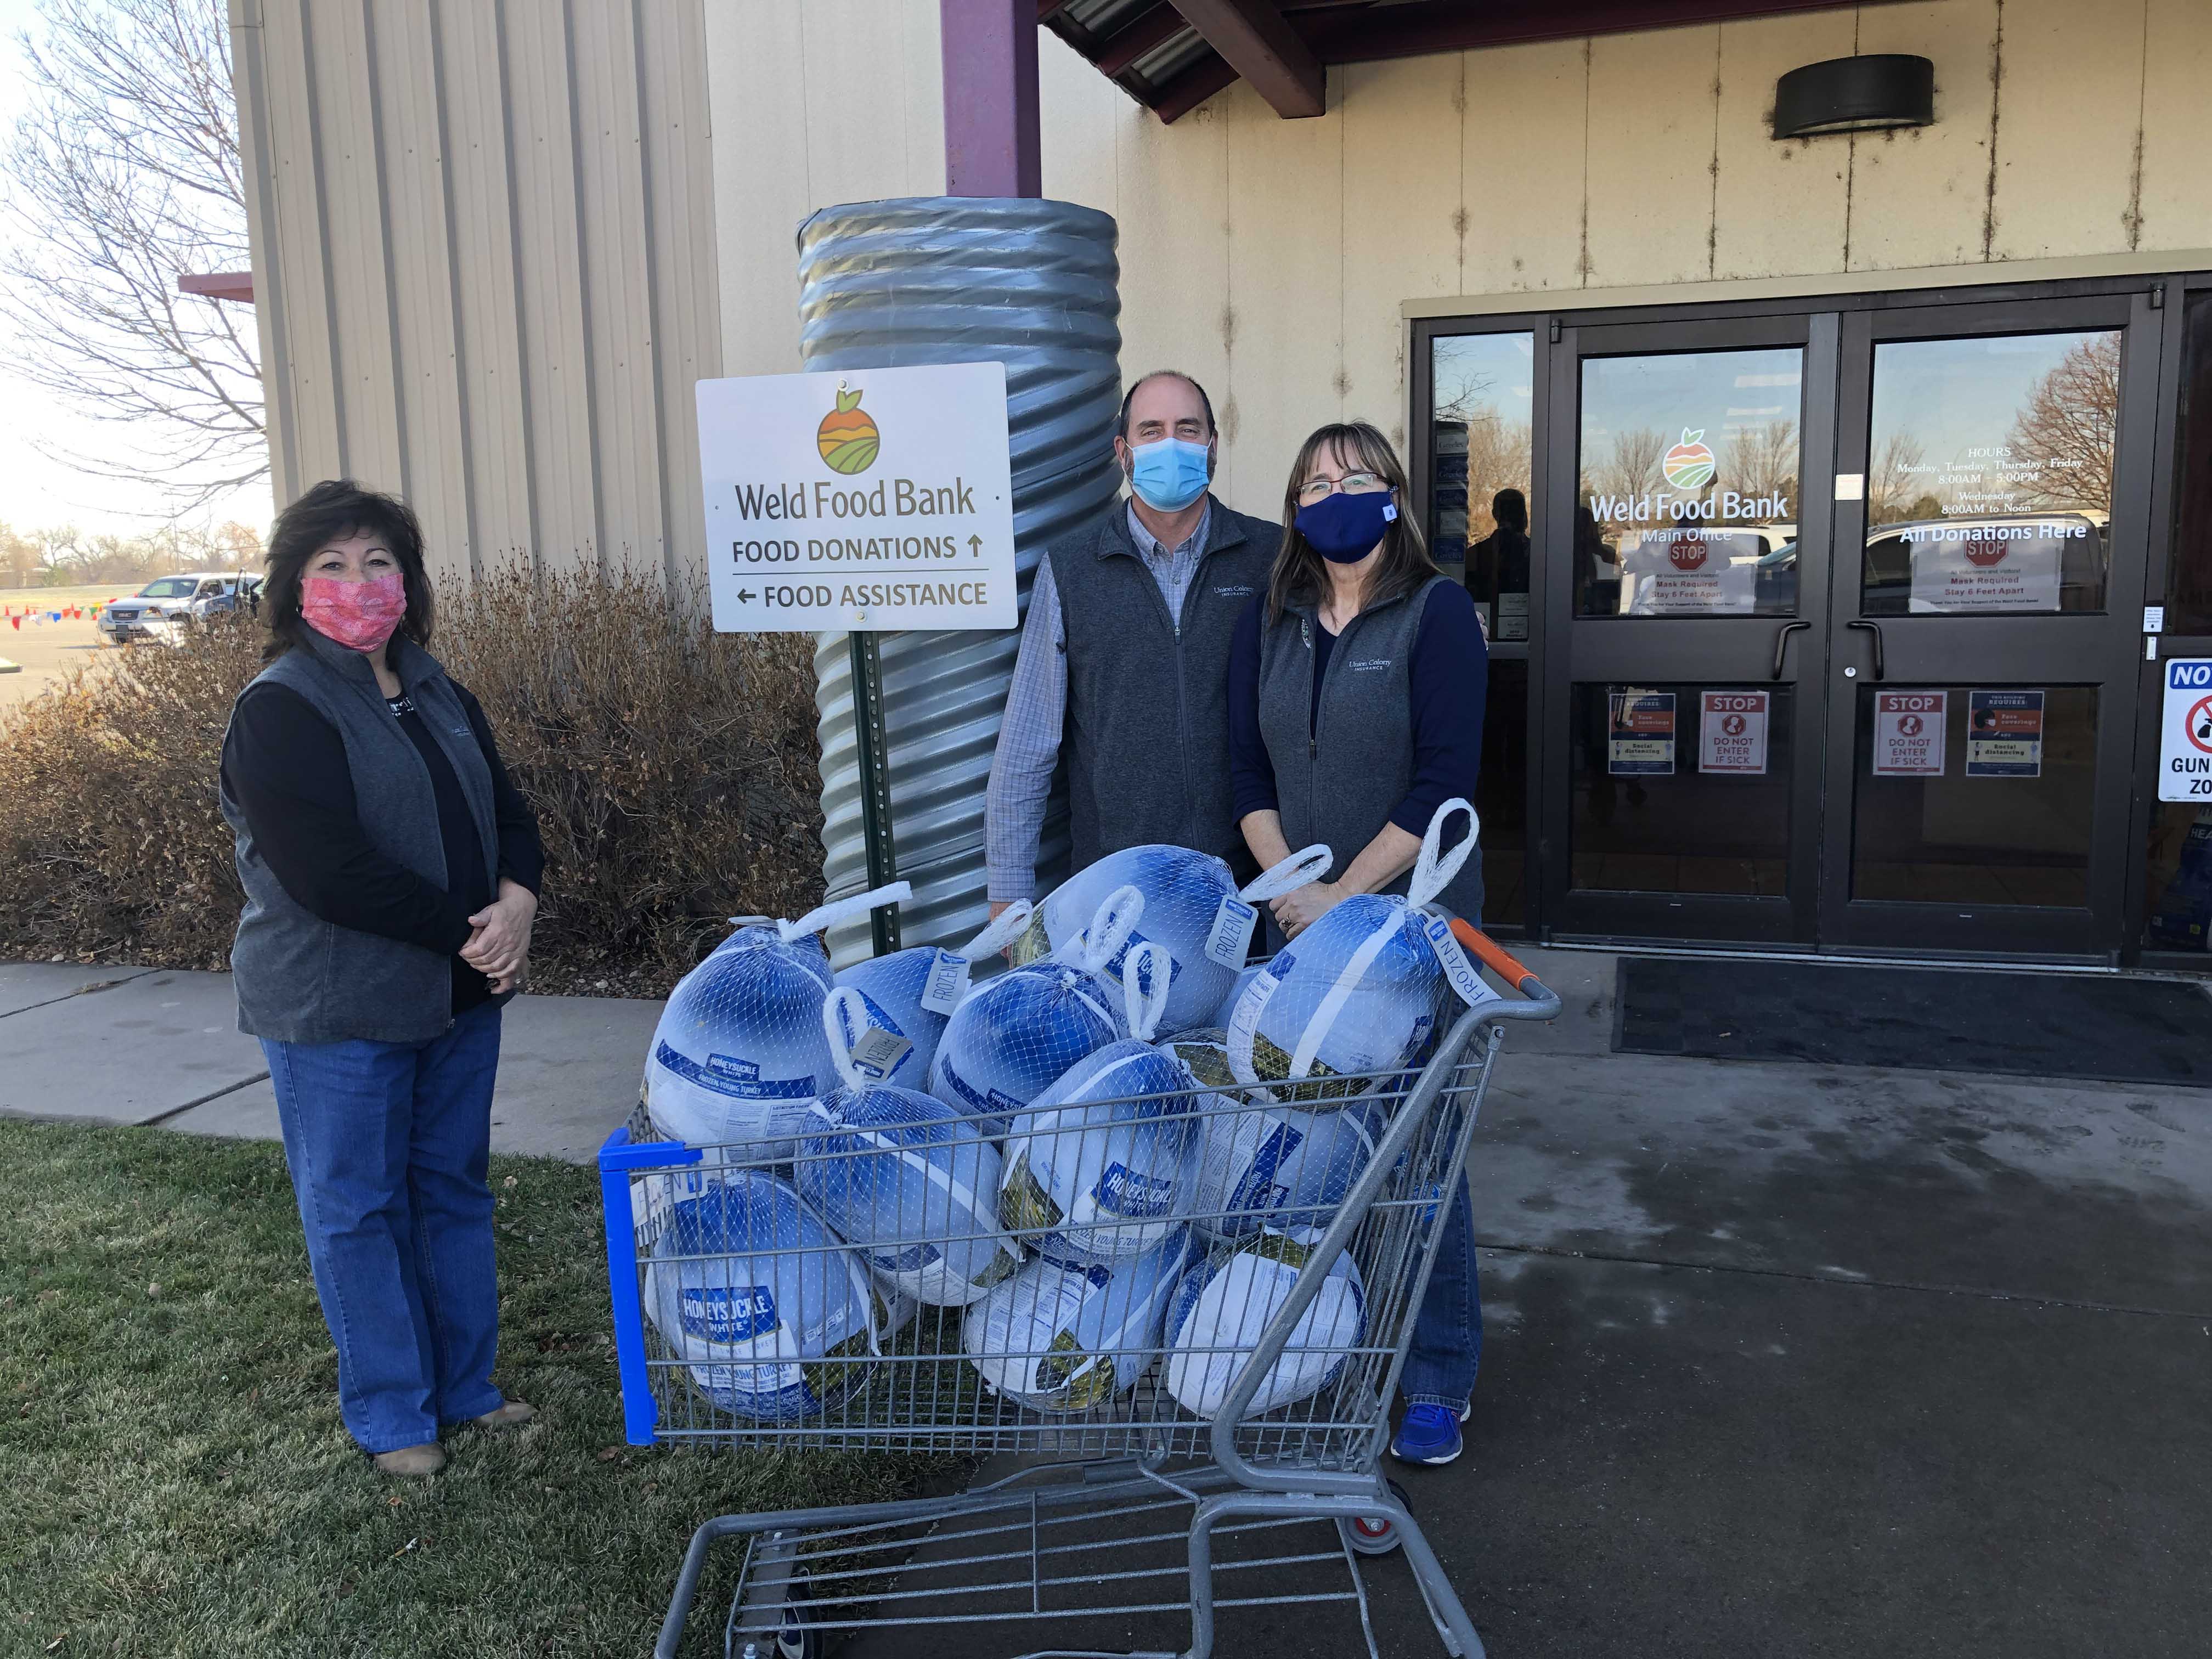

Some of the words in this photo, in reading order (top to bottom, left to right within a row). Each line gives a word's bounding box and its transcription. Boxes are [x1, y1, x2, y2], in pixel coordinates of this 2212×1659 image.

[1967, 447, 2011, 458] HOURS
[1994, 459, 2045, 471] Thursday,
[2050, 458, 2083, 469] Friday
[1938, 474, 1981, 484] 8:00AM
[1996, 472, 2039, 482] 5:00PM
[735, 482, 806, 520] Weld
[815, 480, 886, 518] Food
[894, 477, 975, 517] Bank
[1959, 492, 2015, 501] Wednesday
[1590, 494, 1650, 522] Weld
[1656, 492, 1716, 521] Food
[1723, 490, 1788, 519] Bank
[1941, 504, 1984, 515] 8:00AM
[1989, 505, 1999, 514] to
[2004, 503, 2031, 512] Noon
[1642, 529, 1681, 543] Main
[1686, 527, 1732, 542] Office
[1900, 528, 1925, 543] All
[1931, 525, 2032, 542] Donations
[2039, 524, 2087, 539] Here
[733, 540, 799, 563] FOOD
[808, 536, 957, 561] DONATIONS
[1671, 545, 1707, 561] STOP
[1967, 541, 2006, 555] STOP
[1977, 577, 2019, 585] Required
[765, 585, 832, 607] FOOD
[840, 583, 988, 607] ASSISTANCE
[1945, 588, 1967, 596] Stay
[1369, 658, 1392, 667] Colony
[2174, 665, 2212, 686] NO
[1713, 697, 1757, 711] STOP
[1888, 697, 1934, 710] STOP
[1714, 738, 1730, 746] DO
[1717, 747, 1750, 755] ENTER
[1715, 756, 1725, 764] IF
[1726, 755, 1750, 764] SICK
[2171, 758, 2210, 773] GUN
[2190, 779, 2212, 794] ZO
[1215, 913, 1244, 961] FROZEN
[1440, 940, 1485, 1001] FROZEN
[933, 966, 960, 1001] FROZEN
[864, 1037, 900, 1065] FROZEN
[710, 1057, 758, 1075] HONEYSUCKLE
[723, 1069, 742, 1077] WHITE
[698, 1073, 719, 1087] FROZEN
[720, 1081, 740, 1092] YOUNG
[741, 1086, 762, 1095] TURKEY
[1107, 1172, 1172, 1203] HONEYSUCKL
[683, 1295, 769, 1321] HONEYSUCKLE
[709, 1321, 743, 1333] WHITE
